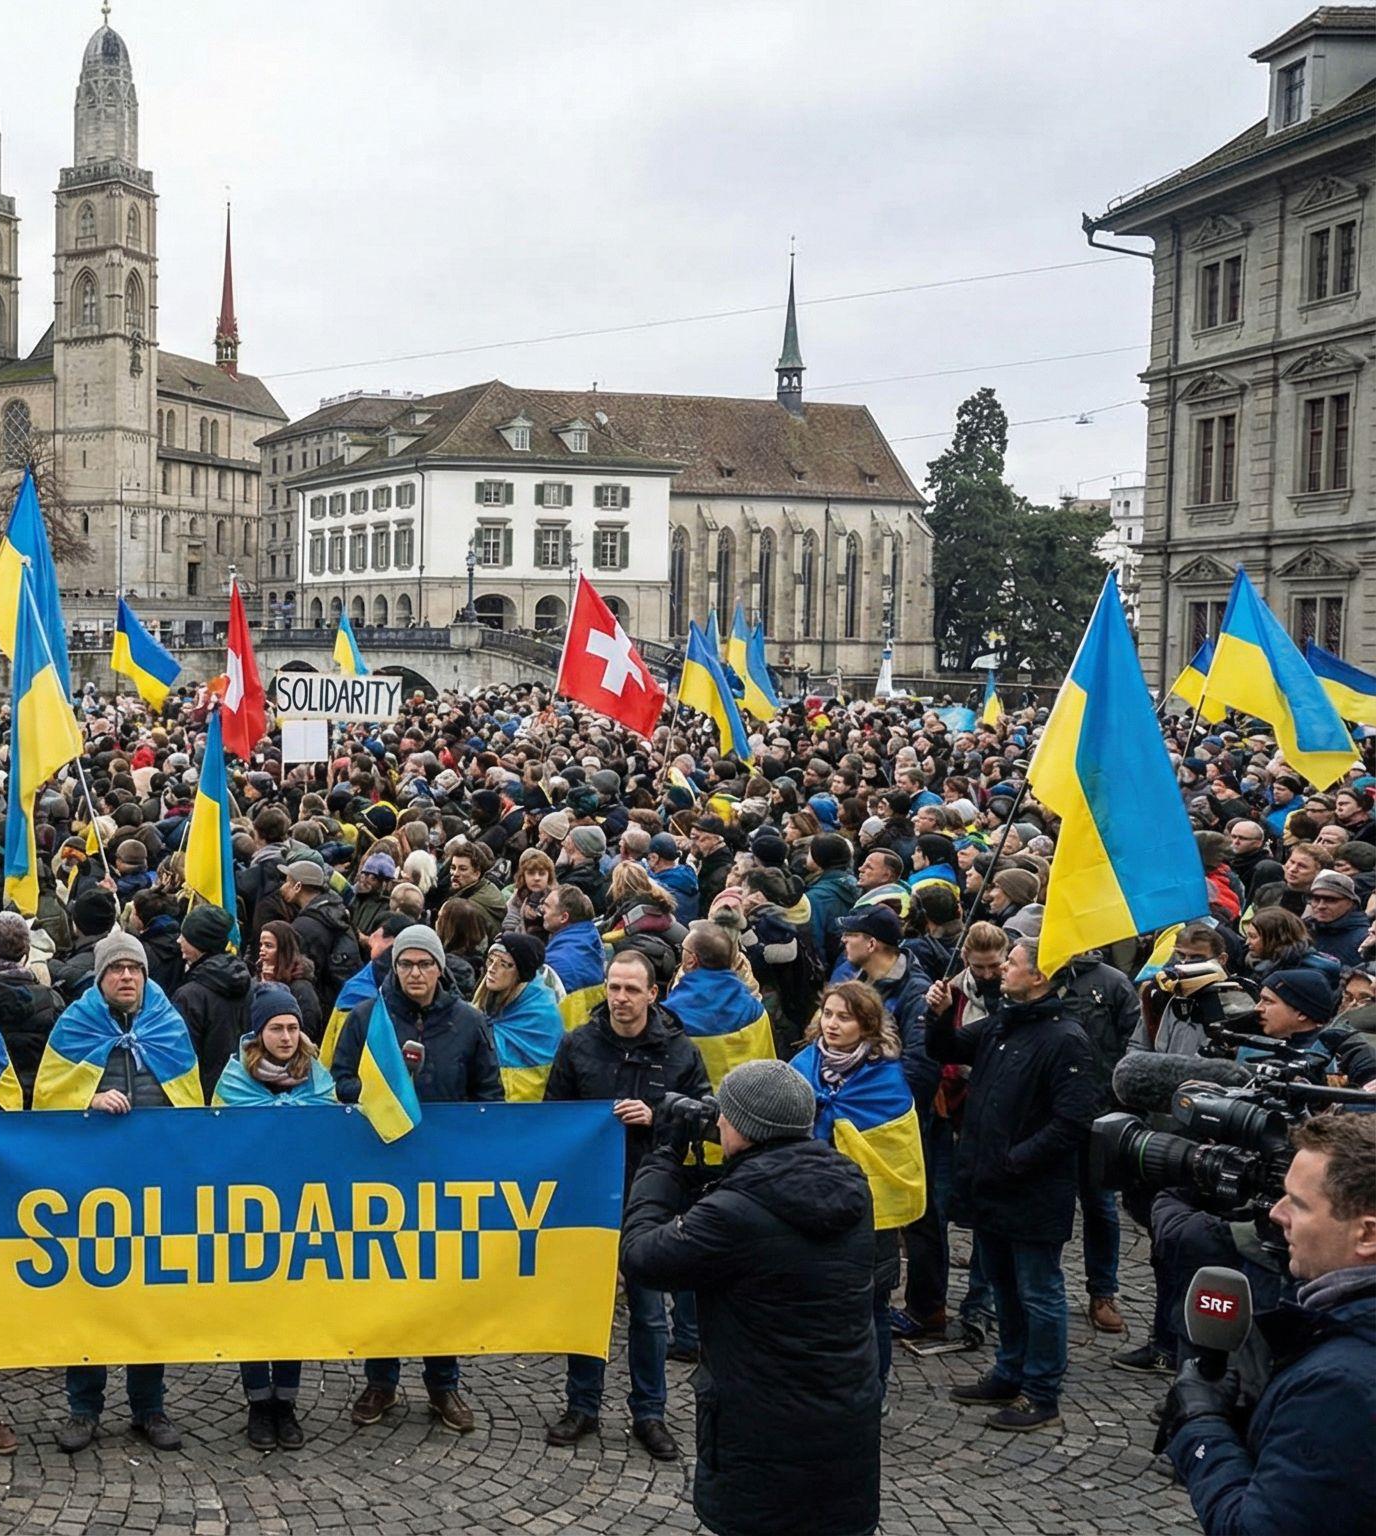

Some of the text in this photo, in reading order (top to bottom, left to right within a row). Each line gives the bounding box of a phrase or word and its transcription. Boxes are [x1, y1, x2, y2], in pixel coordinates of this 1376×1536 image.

[277, 677, 401, 716] SOLIDARITY
[16, 1180, 558, 1288] SOLIDARITY
[1200, 1295, 1234, 1313] SRF
